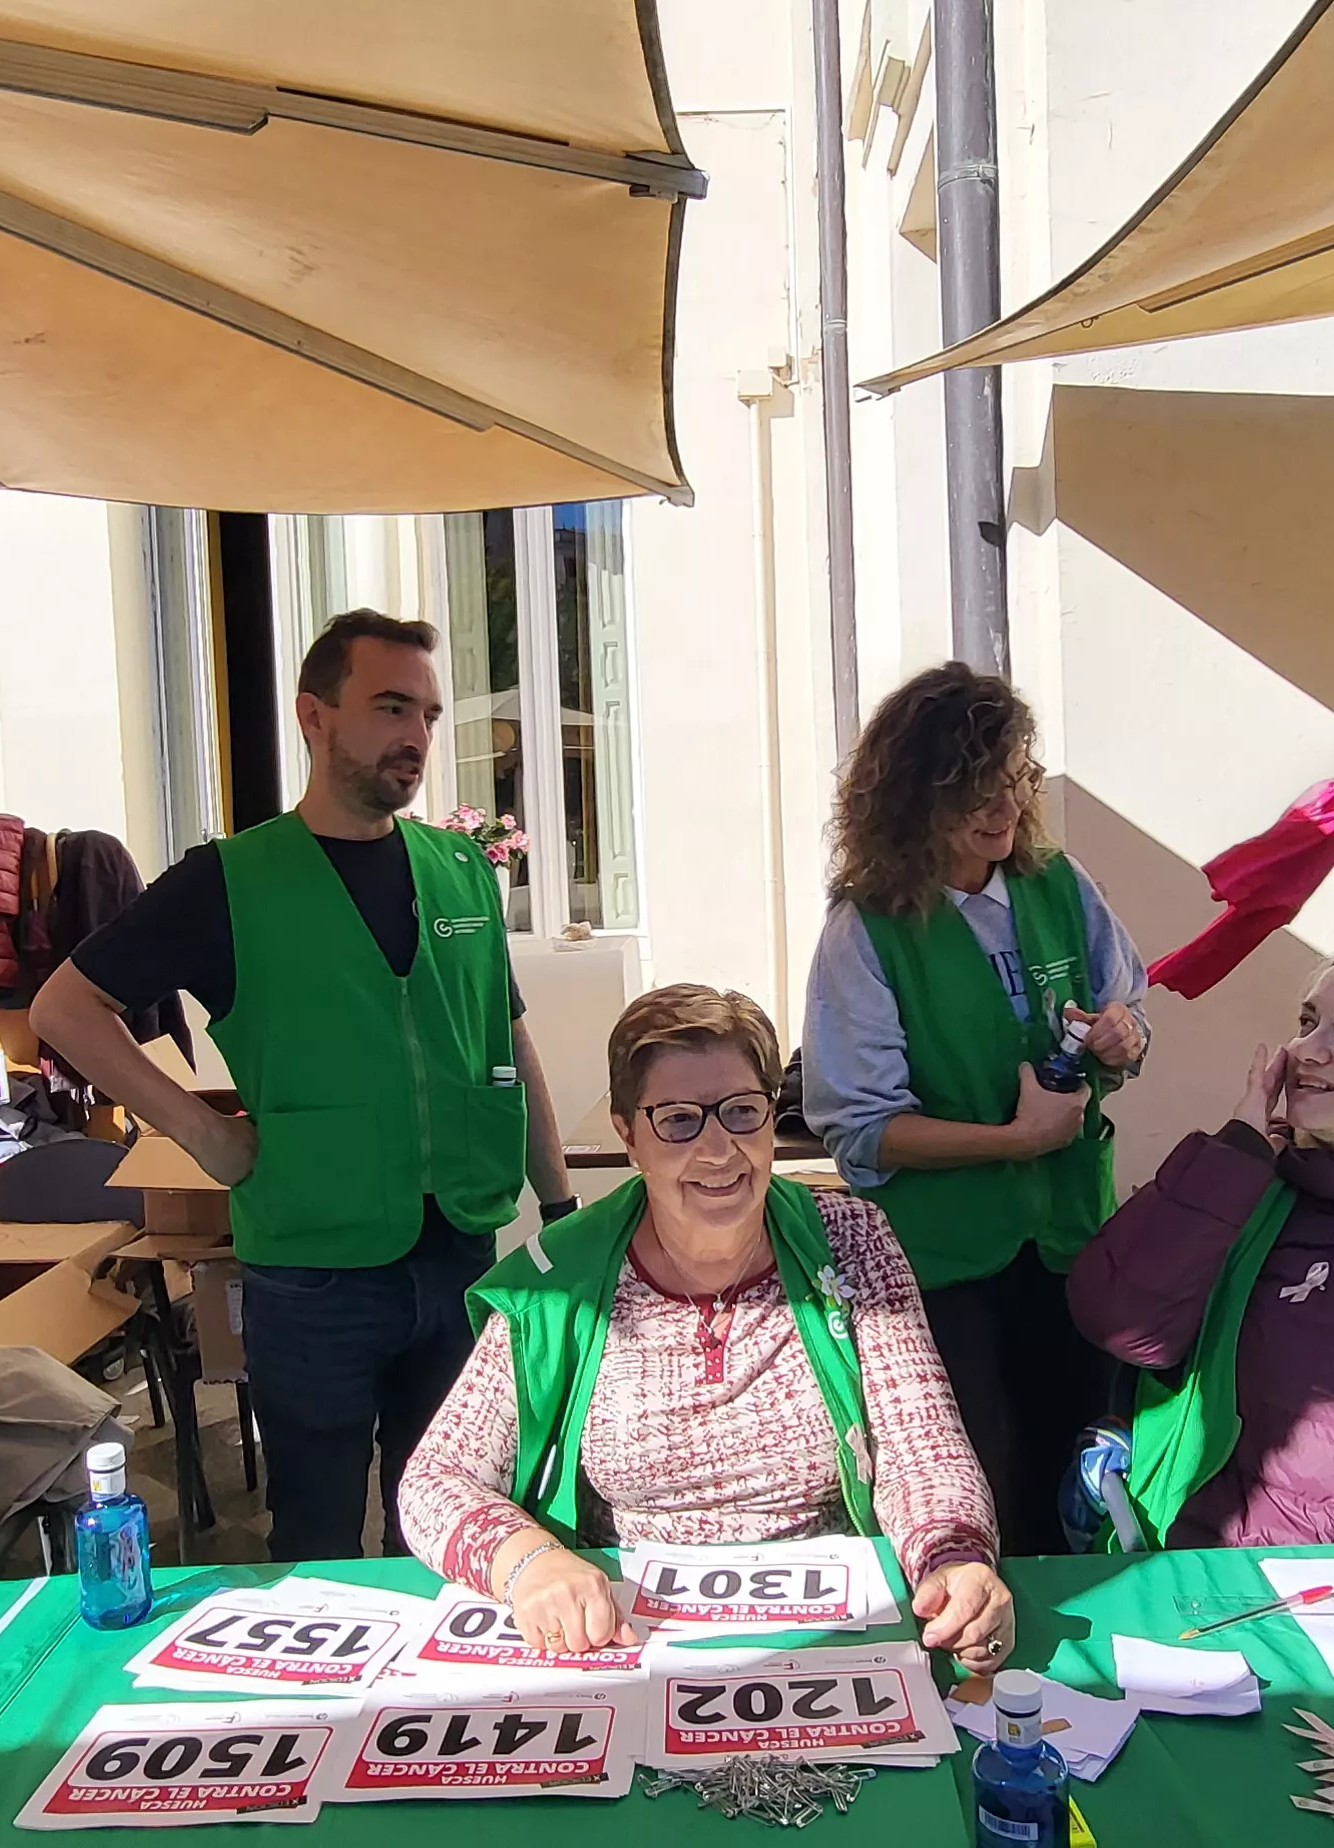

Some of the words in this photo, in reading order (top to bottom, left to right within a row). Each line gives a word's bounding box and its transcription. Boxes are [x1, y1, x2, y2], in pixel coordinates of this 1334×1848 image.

[654, 1566, 838, 1600] 1301
[647, 1598, 724, 1617] CÁNCER
[726, 1604, 748, 1614] EL
[751, 1603, 836, 1614] CONTRA
[710, 1613, 769, 1622] HUESCA
[182, 1615, 372, 1659] 1557
[171, 1647, 247, 1668] CÁNCER
[435, 1641, 515, 1660] CÁNCER
[517, 1647, 541, 1660] EL
[249, 1657, 272, 1669] EL
[273, 1659, 353, 1675] CONTRA
[498, 1656, 555, 1667] HUESCA
[225, 1664, 282, 1680] HUESCA
[676, 1677, 897, 1725] 1202
[375, 1712, 598, 1757] 1419
[678, 1729, 770, 1745] CÁNCER
[772, 1726, 800, 1740] EL
[804, 1721, 902, 1738] CONTRA
[758, 1738, 825, 1750] HUESCA
[85, 1733, 308, 1781] 1509
[366, 1763, 459, 1778] CÁNCER
[463, 1762, 490, 1775] EL
[493, 1761, 590, 1775] CONTRA
[441, 1774, 508, 1785] HUESCA
[68, 1787, 161, 1804] CÁNCER
[167, 1786, 193, 1800] EL
[197, 1783, 293, 1800] CONTRA
[139, 1799, 206, 1811] HUESCA
